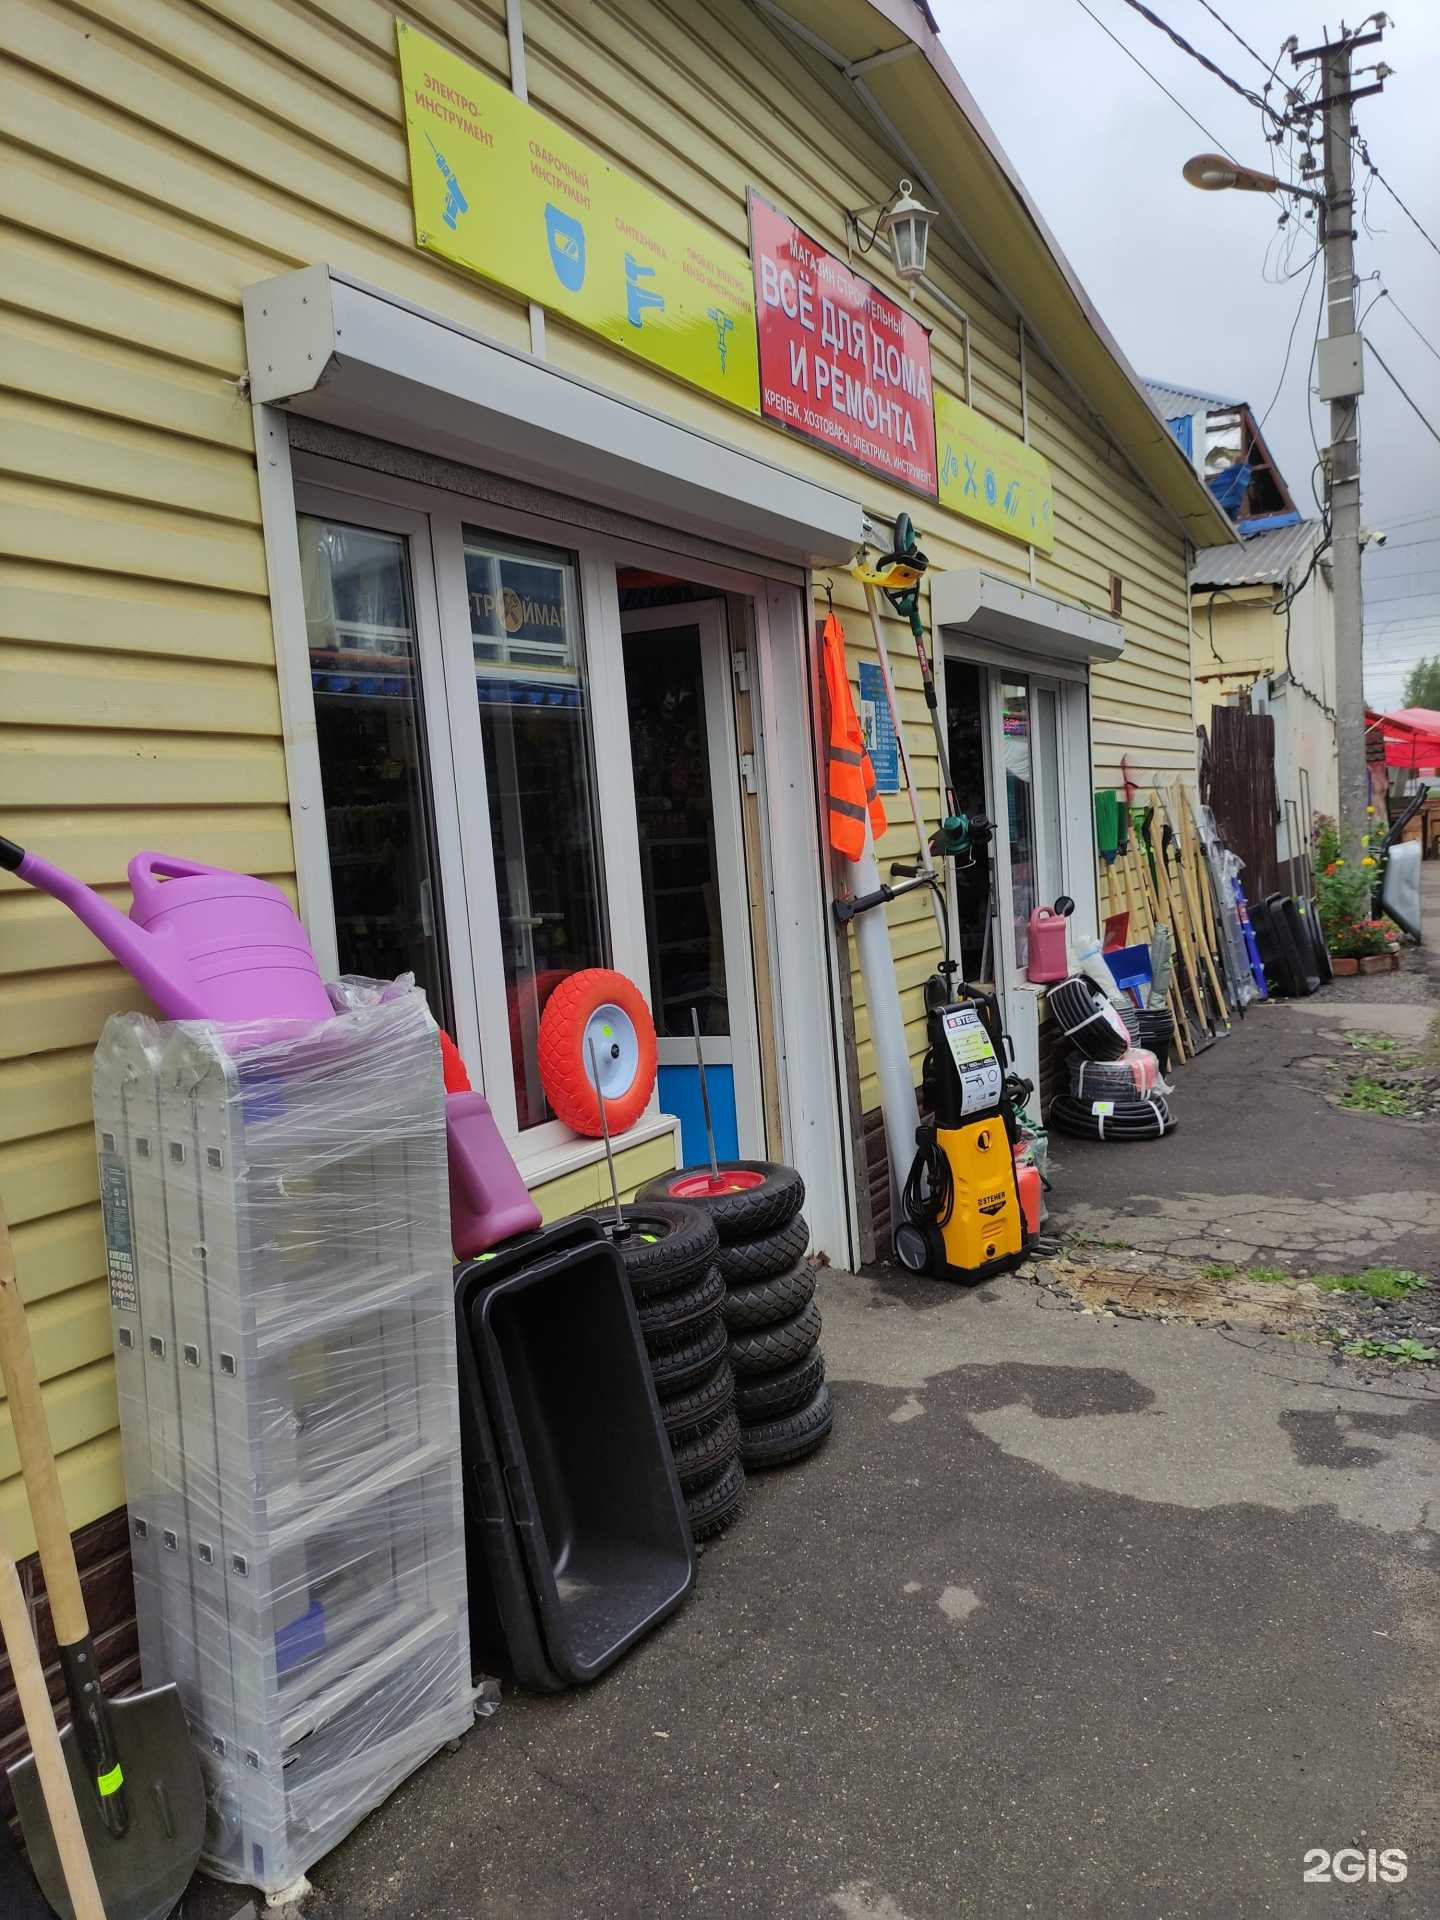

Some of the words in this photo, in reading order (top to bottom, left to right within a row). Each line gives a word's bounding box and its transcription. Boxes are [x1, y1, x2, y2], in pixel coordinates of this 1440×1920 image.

[415, 89, 493, 148] ИНСТРУМЕНТ
[424, 72, 482, 117] ЭЛЕКТРО-
[529, 140, 589, 190] СВАРОЧНЫЙ
[530, 160, 591, 210] ИНСТРУМЕНТ
[789, 238, 835, 287] МАГАЗИН
[838, 274, 905, 337] СТРОИТЕЛЬНЫЙ
[761, 255, 815, 333] ВСЁ
[821, 298, 867, 368] ДЛЯ
[872, 335, 930, 406] ДОМА
[764, 388, 802, 421] КРЕПЁЖ,
[803, 407, 852, 448] ХОЗТОВАРЫ,
[789, 340, 808, 393] И
[814, 354, 917, 452] РЕМОНТА
